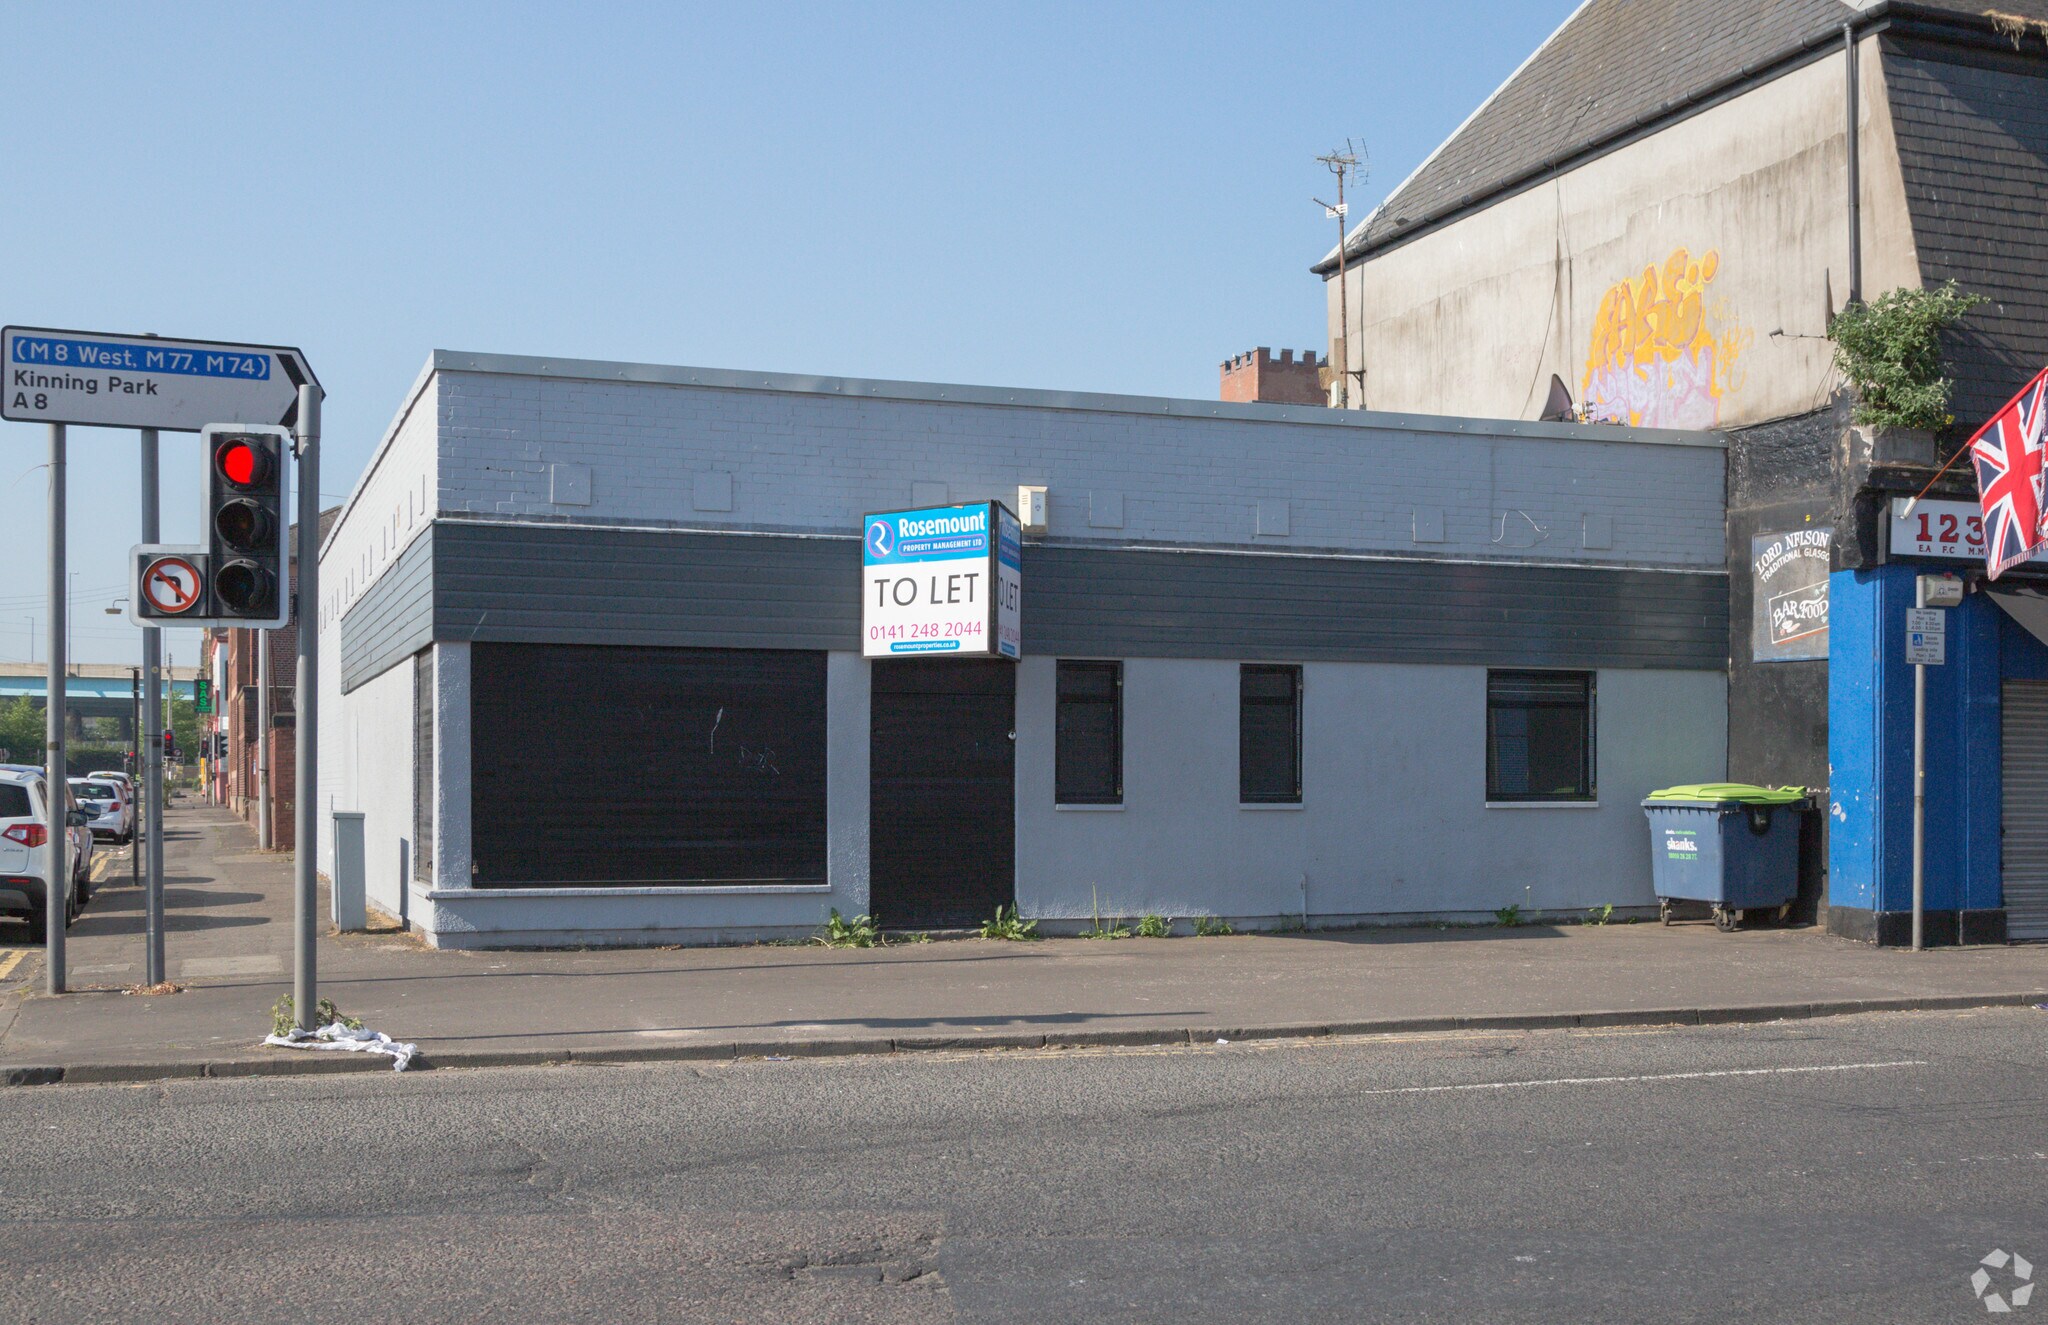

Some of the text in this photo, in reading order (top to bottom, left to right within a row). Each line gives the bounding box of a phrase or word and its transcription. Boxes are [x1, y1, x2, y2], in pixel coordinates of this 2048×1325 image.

[78, 345, 138, 368] West,
[13, 369, 159, 396] Kinning Park
[898, 511, 986, 538] Rosemount
[902, 538, 983, 552] PROPERTY MANAGEMENT LTD
[1755, 530, 1830, 576] LORD NELSON
[1761, 547, 1830, 583] TRADITIONAL GLASGO
[874, 573, 980, 608] TO LET
[1005, 580, 1019, 613] LET
[1773, 594, 1829, 627] BAR FOOD
[870, 624, 905, 640] 0141
[911, 623, 939, 639] 248
[944, 621, 982, 637] 2044
[893, 641, 957, 650] rosemountproperties.co.uk
[199, 681, 207, 706] SAS
